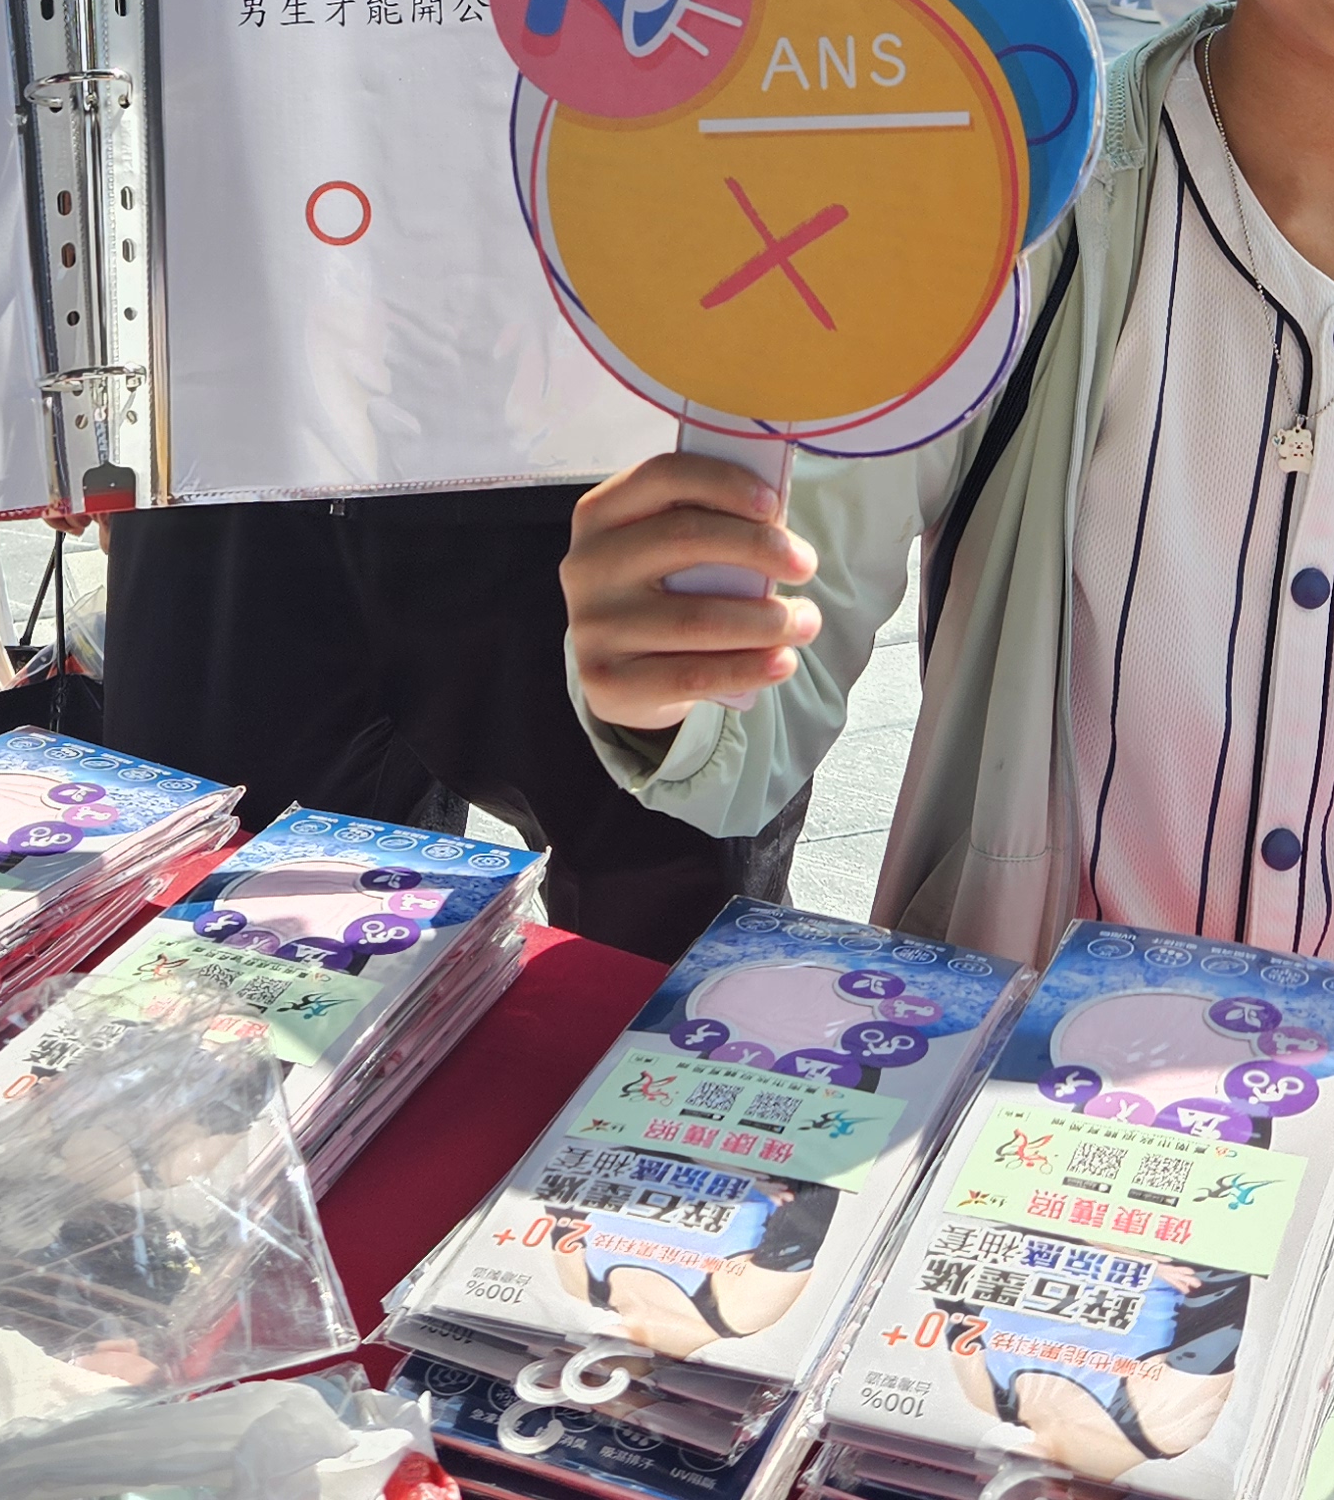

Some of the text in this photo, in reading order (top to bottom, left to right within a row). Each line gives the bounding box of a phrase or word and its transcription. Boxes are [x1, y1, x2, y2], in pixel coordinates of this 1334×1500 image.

[760, 30, 909, 93] ANS
[642, 1117, 797, 1166] 健康護照
[1026, 1188, 1195, 1246] 健康護照
[934, 1222, 1156, 1293] 超涼感袖套
[465, 1279, 525, 1305] 100%
[860, 1387, 925, 1419] 100%
